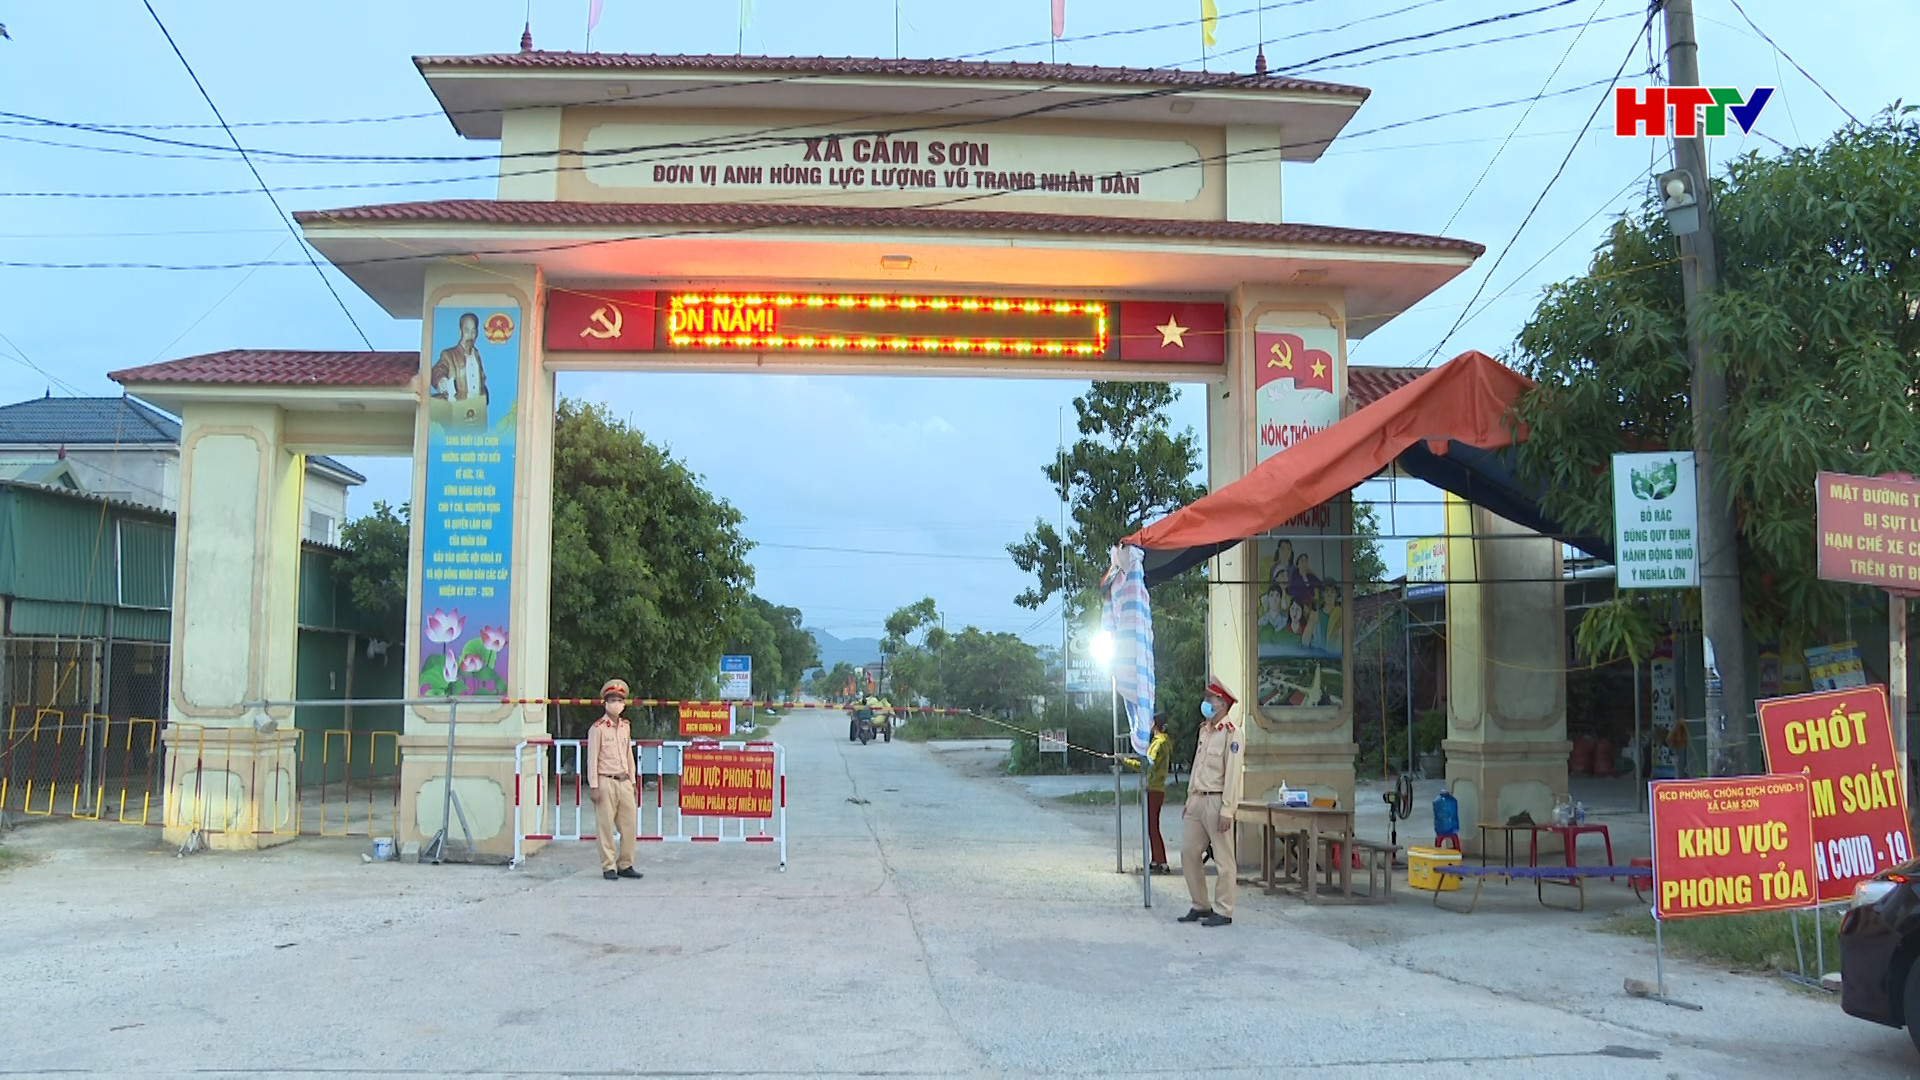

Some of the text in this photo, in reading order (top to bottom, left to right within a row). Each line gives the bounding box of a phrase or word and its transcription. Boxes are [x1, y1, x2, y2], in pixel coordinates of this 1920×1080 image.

[928, 140, 989, 166] SƠN
[653, 163, 1140, 194] ĐƠN VỊ ANH HÙNG LỰC LƯỢNG VŨ TRANG NHÂN DÂN
[712, 300, 774, 332] NĂM!
[1260, 418, 1288, 447] NÔNG
[1829, 483, 1859, 504] MẶT
[1862, 488, 1909, 508] ĐƯỜNG
[1863, 512, 1920, 533] BỊ SỤT L
[1649, 529, 1667, 542] QUY
[1824, 531, 1920, 556] HẠN CHẾ XE C
[1850, 557, 1885, 577] TRÊN
[1784, 702, 1867, 755] CHỐT
[683, 764, 772, 789] KHU VỰC PHONG TỎA
[1839, 763, 1897, 814] SOÁT
[682, 792, 705, 810] KHÔNG
[727, 796, 738, 813] SỰ
[758, 796, 772, 812] VÀO
[1745, 786, 1766, 798] DỊCH
[1767, 783, 1804, 794] COVID-19
[1742, 799, 1760, 809] SƠN
[1677, 820, 1788, 859] KHU VỰC
[1828, 834, 1876, 880] COVID
[1885, 830, 1908, 867] 19
[1662, 875, 1752, 910] PHONG
[1758, 861, 1808, 902] TỎA
